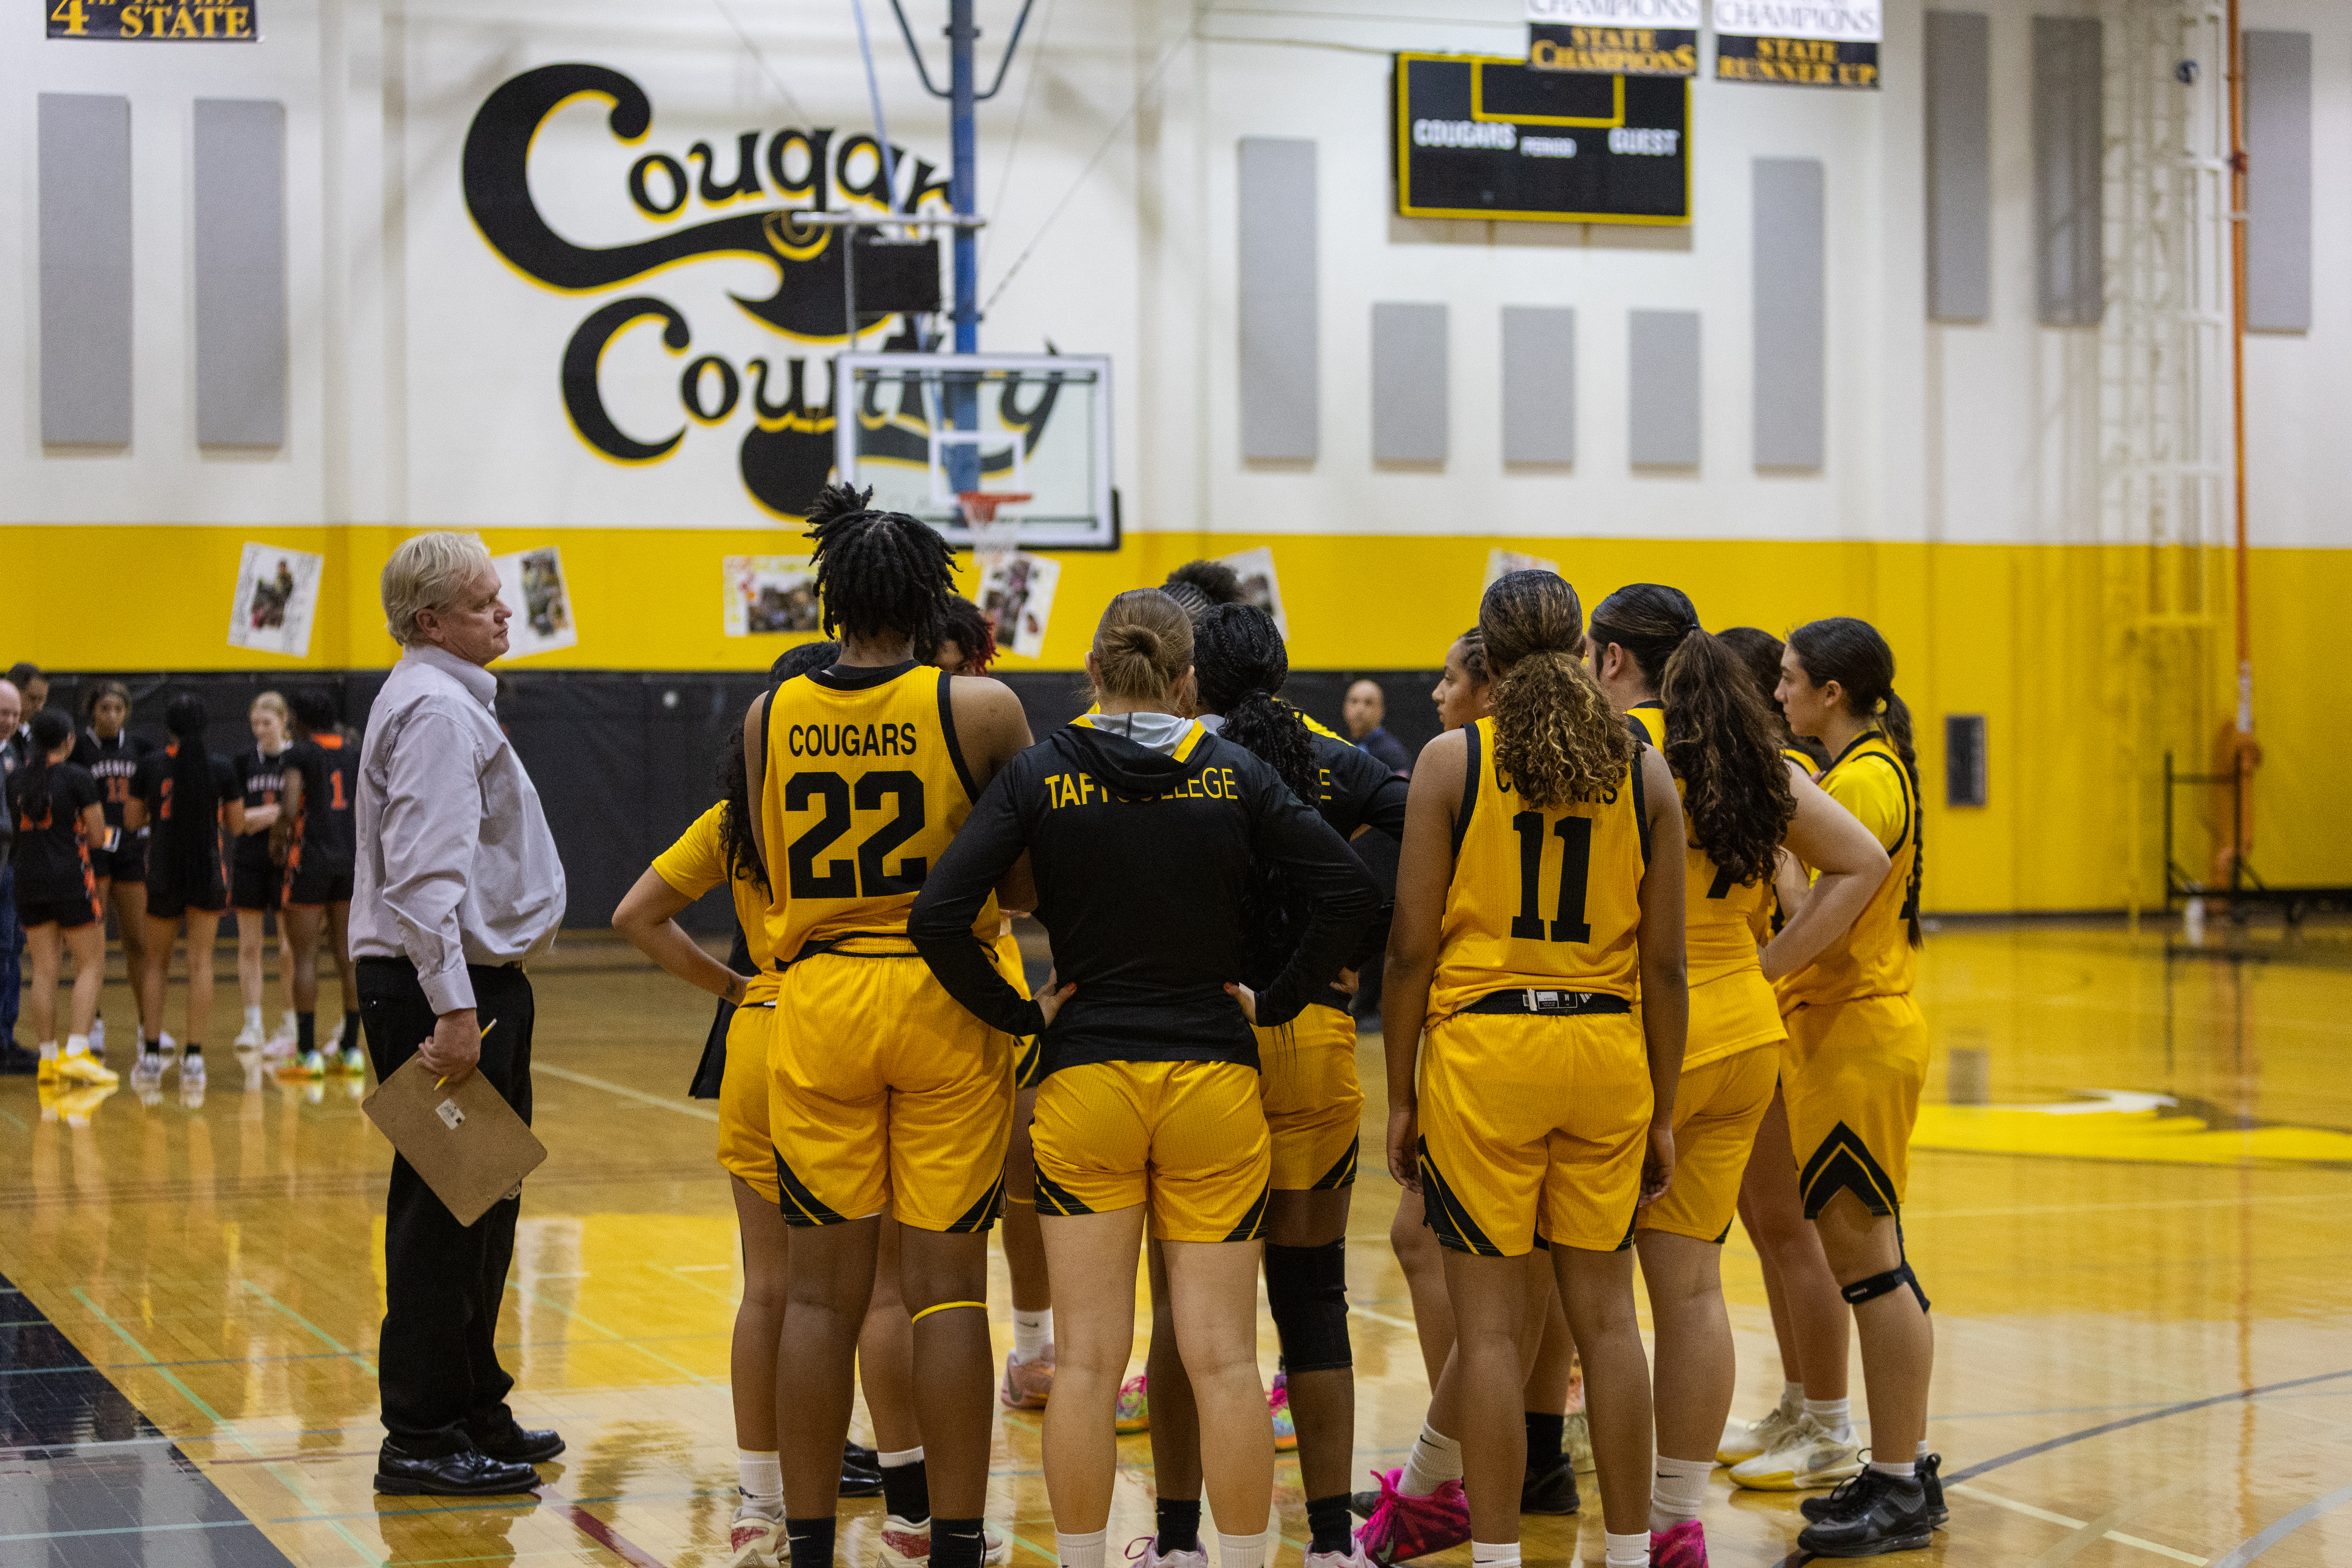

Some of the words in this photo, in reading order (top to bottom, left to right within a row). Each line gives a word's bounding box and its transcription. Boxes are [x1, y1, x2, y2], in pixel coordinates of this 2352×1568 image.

[120, 5, 251, 38] STATE
[1608, 127, 1680, 156] GUEST
[789, 722, 917, 757] COUGARS
[785, 770, 927, 899] 22
[1511, 810, 1592, 944] 11
